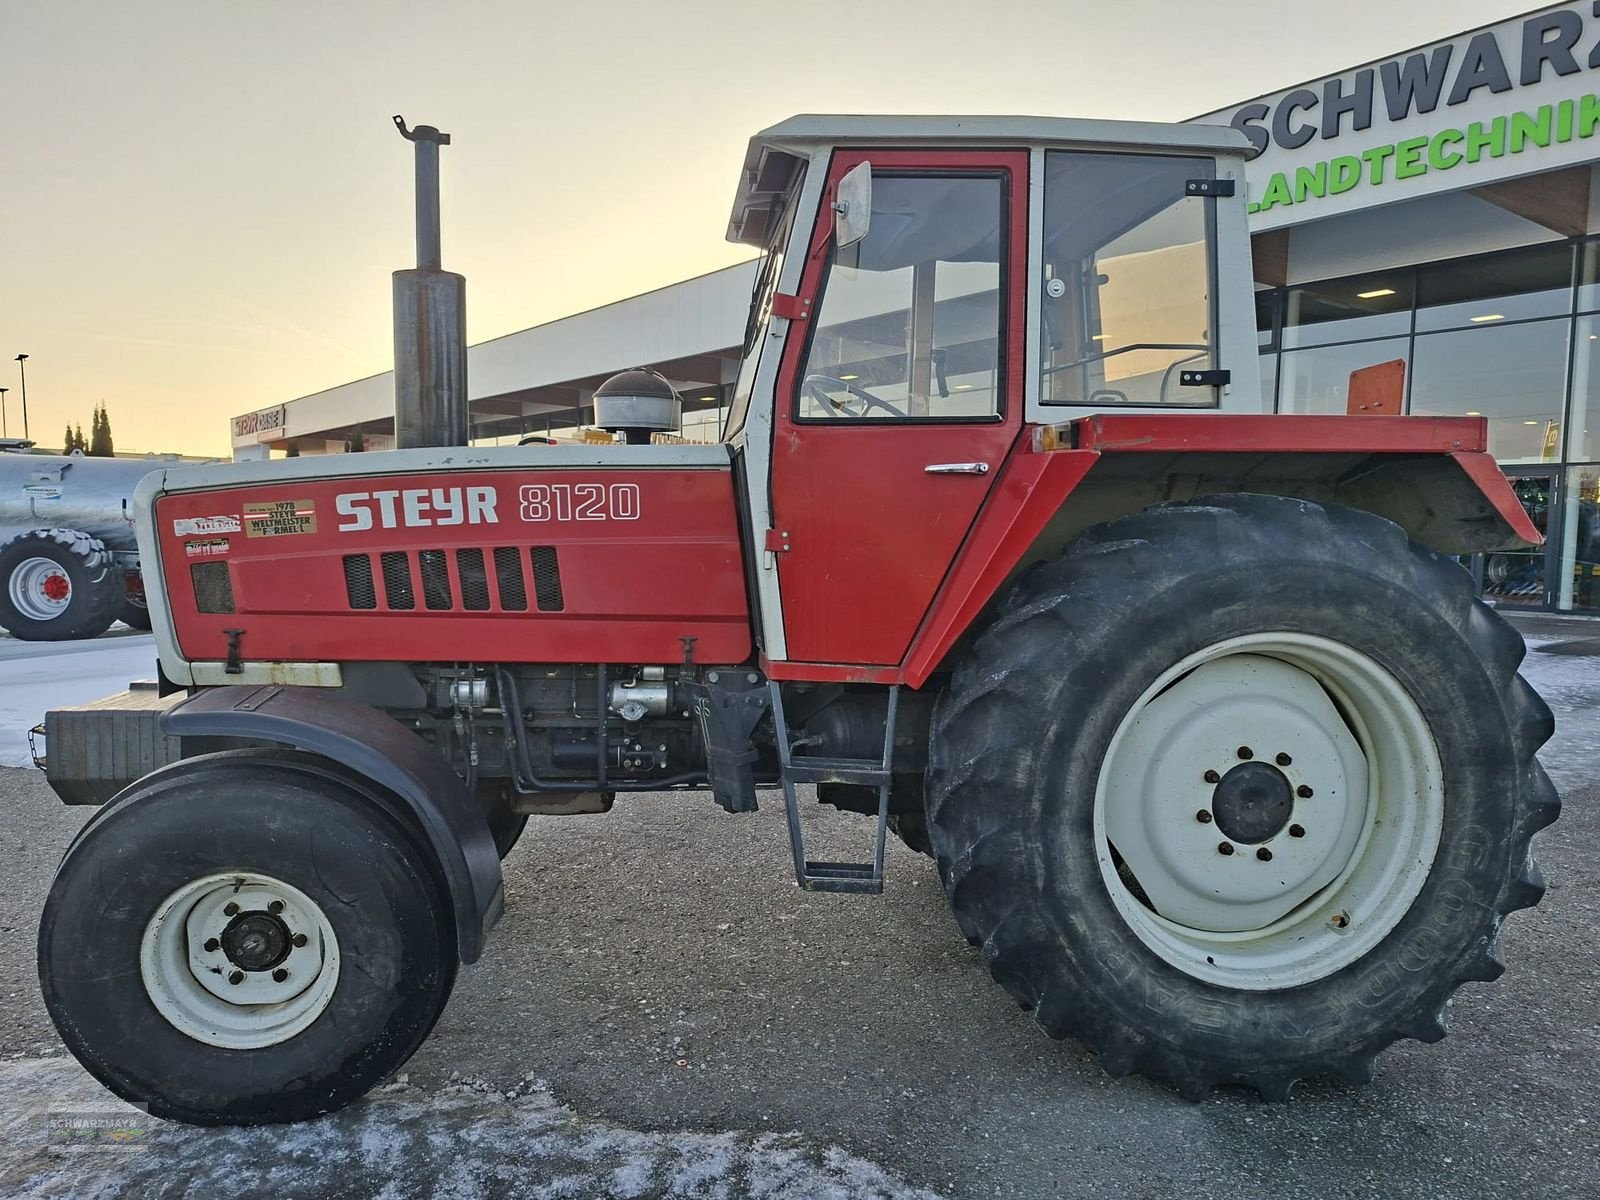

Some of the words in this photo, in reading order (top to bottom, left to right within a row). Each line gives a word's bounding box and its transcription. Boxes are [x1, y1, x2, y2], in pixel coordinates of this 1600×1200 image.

[1230, 0, 1600, 162] SCHWAR
[274, 502, 295, 511] 1978
[335, 485, 500, 532] STEYR
[519, 483, 640, 522] 8120
[268, 510, 297, 519] STEYR
[250, 516, 311, 528] WELTMEISTER
